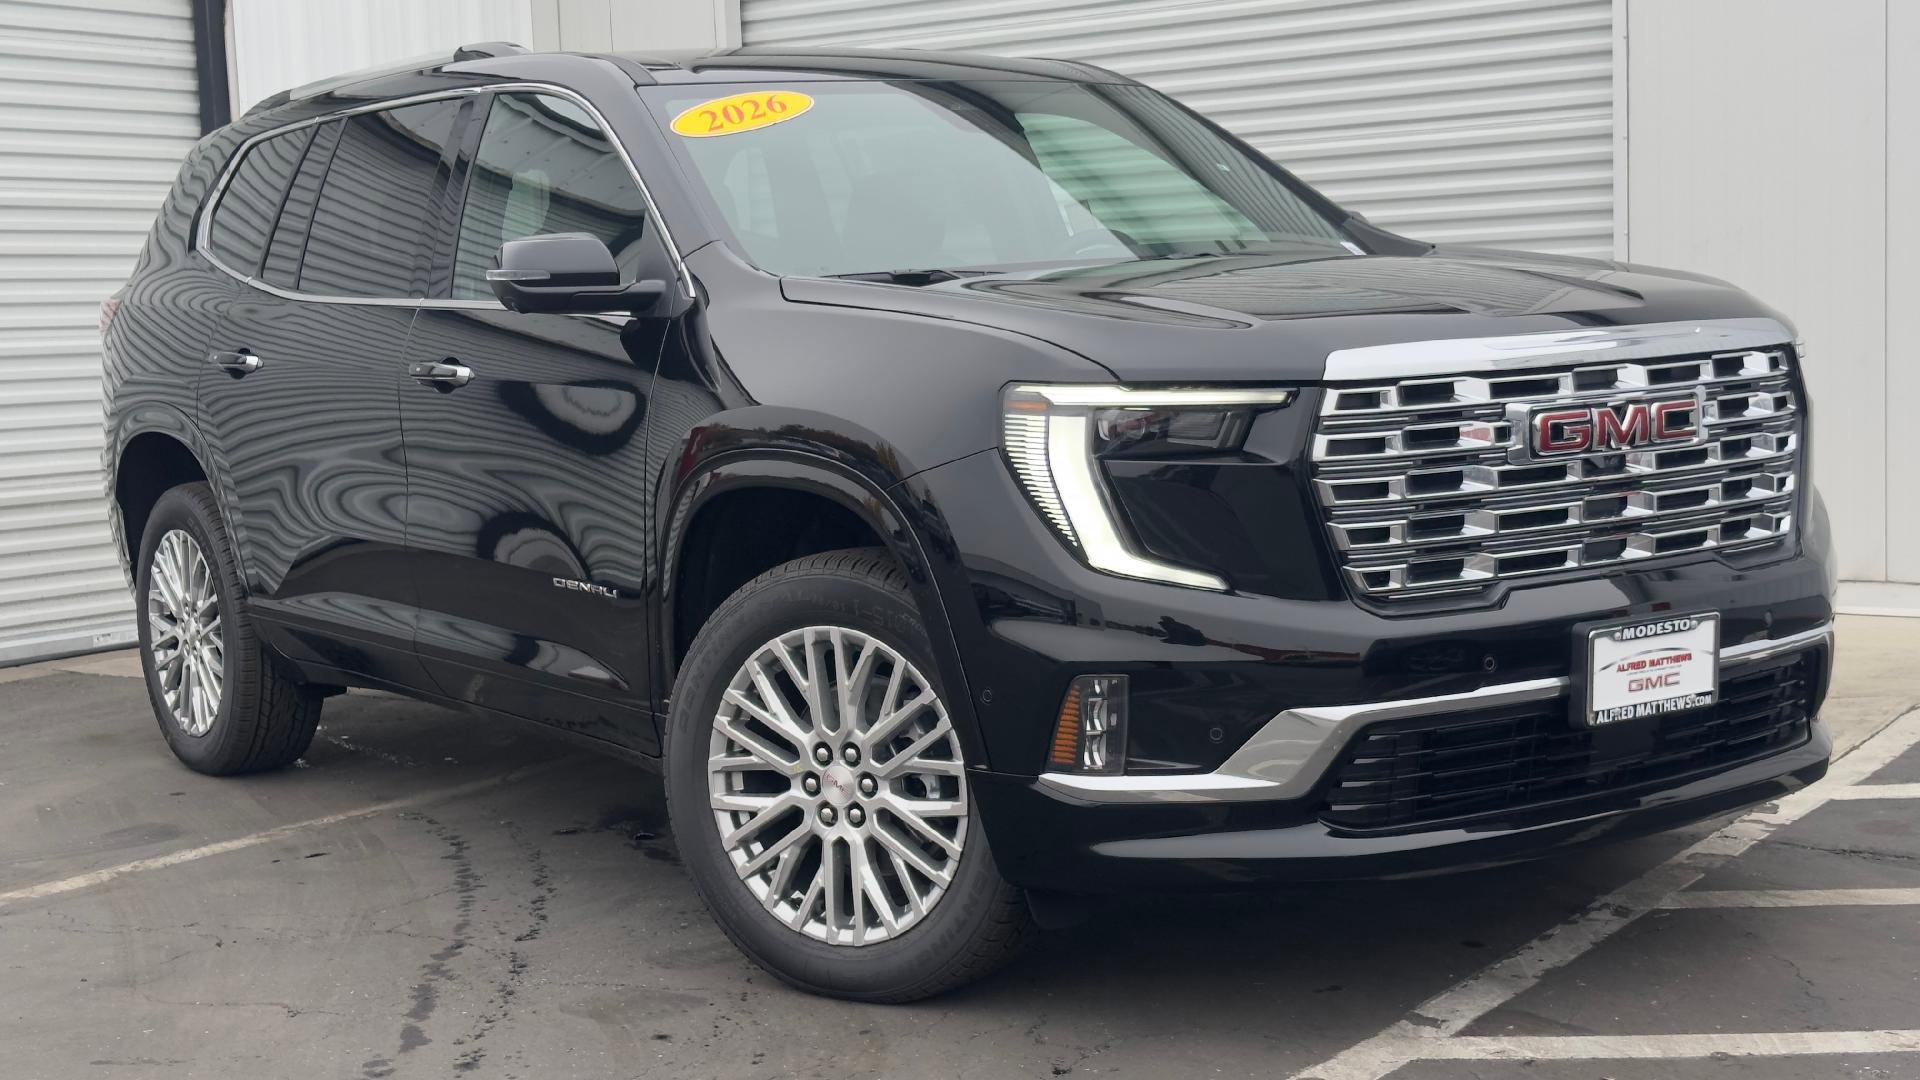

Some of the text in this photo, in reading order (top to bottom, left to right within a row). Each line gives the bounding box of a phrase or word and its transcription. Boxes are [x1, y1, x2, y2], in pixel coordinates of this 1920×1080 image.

[698, 95, 787, 132] 2026
[1534, 400, 1698, 456] GMC
[552, 577, 617, 599] DENALI
[1622, 619, 1690, 639] MODESTO
[1616, 660, 1646, 672] ALFRED
[1649, 653, 1692, 667] MATTHEWS
[1628, 672, 1681, 692] GMC
[1597, 705, 1634, 724] ALFRED
